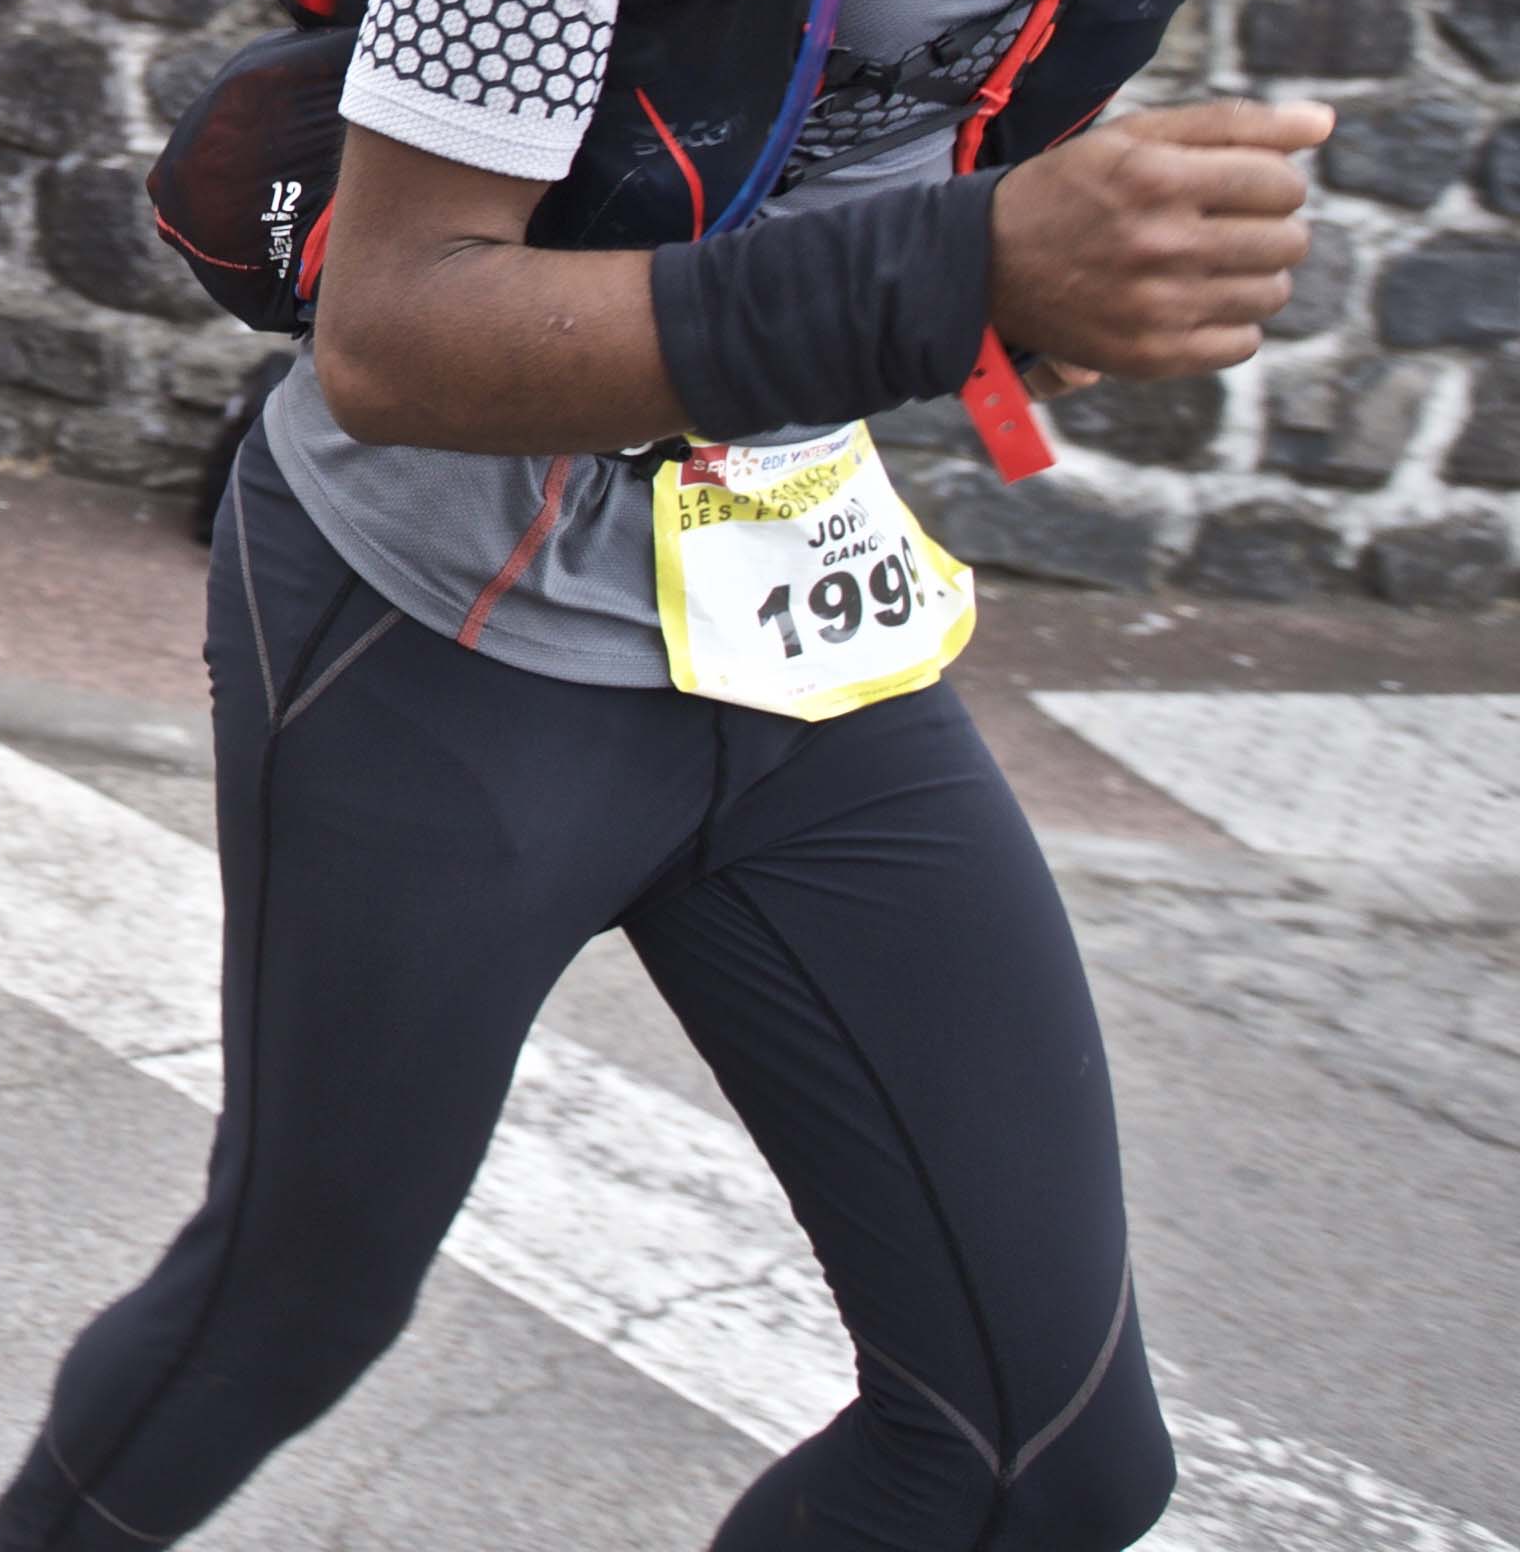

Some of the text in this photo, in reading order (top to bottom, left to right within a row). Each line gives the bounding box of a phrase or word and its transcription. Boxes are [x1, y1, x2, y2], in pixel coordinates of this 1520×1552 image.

[270, 180, 302, 212] 12
[678, 489, 711, 511] LA
[680, 504, 733, 531] DES
